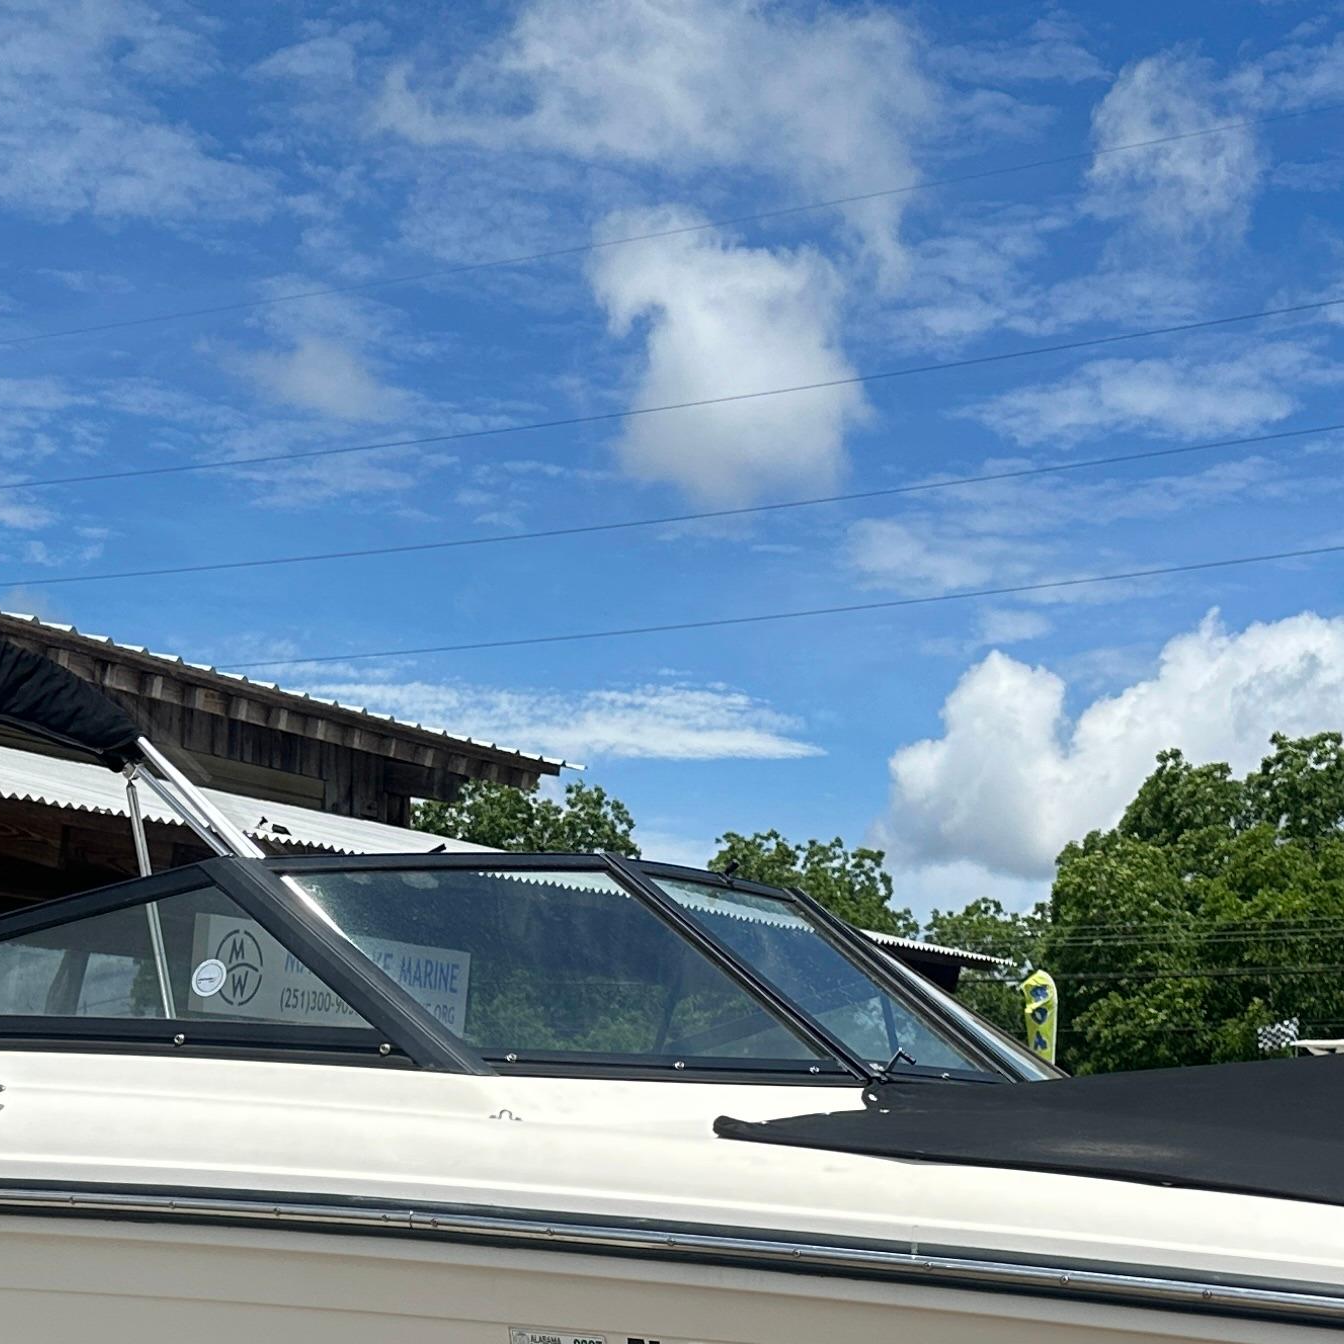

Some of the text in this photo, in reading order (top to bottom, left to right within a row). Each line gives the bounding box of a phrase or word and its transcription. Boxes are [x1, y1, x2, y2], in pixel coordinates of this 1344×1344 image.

[228, 938, 245, 964] M
[231, 970, 249, 998] W
[399, 957, 460, 994] MARINE
